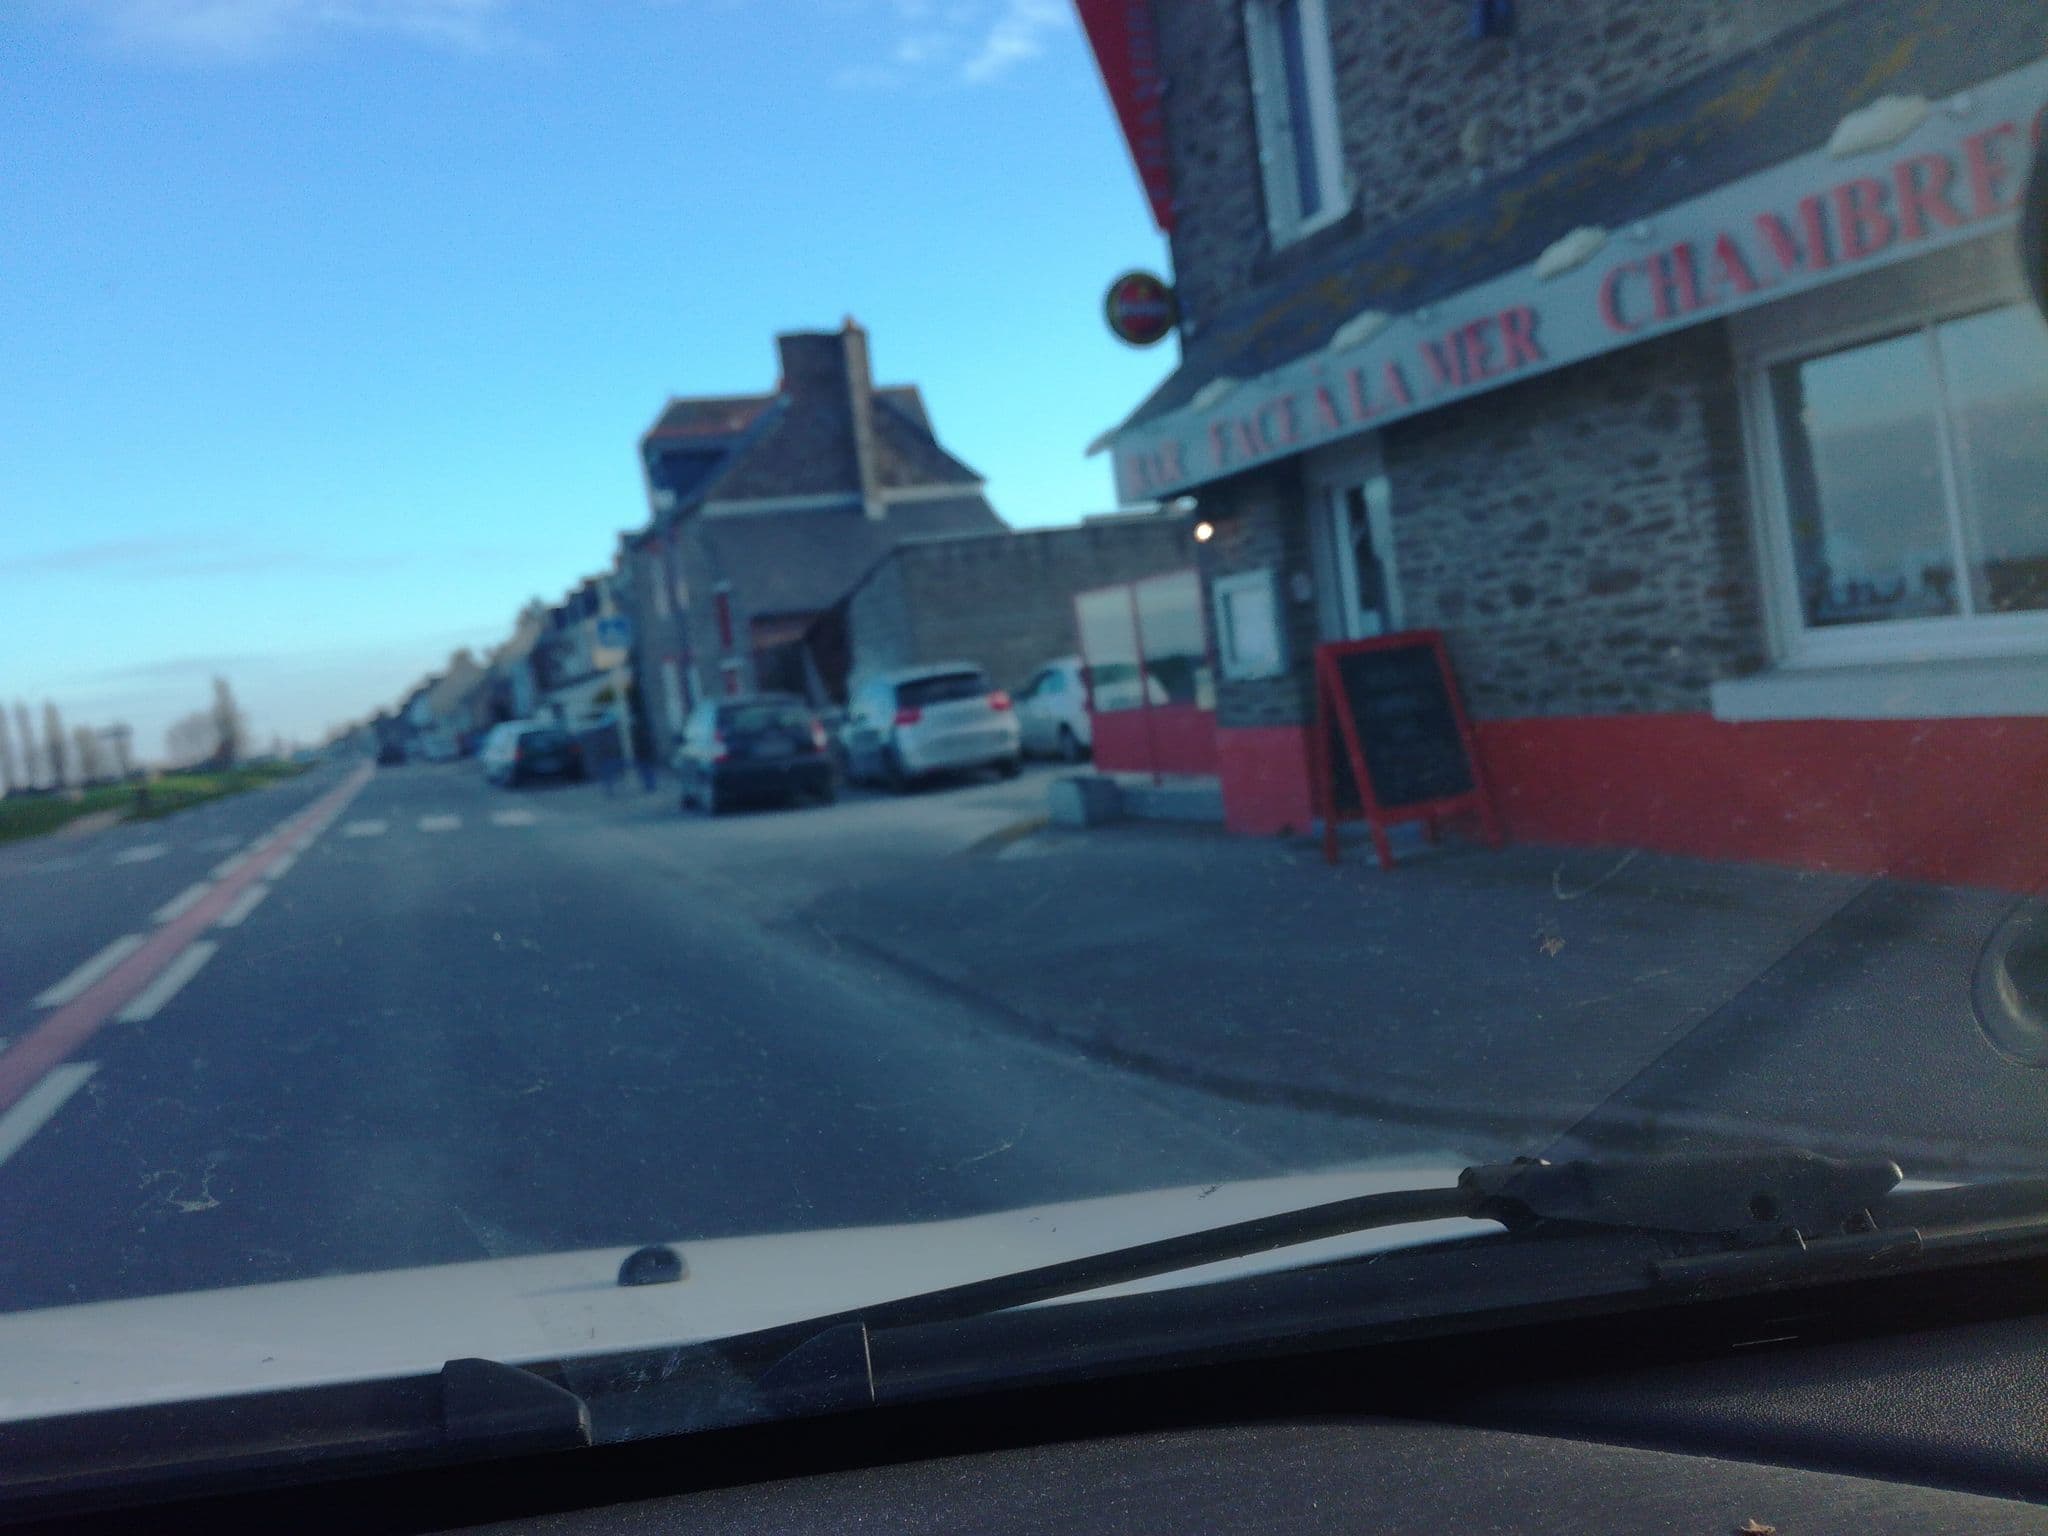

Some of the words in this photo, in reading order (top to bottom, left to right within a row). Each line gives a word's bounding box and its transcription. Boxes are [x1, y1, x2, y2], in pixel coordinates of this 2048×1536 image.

[1208, 393, 1303, 471] FACE
[1417, 304, 1542, 396] MER
[1598, 105, 2048, 335] CHAMBRE
